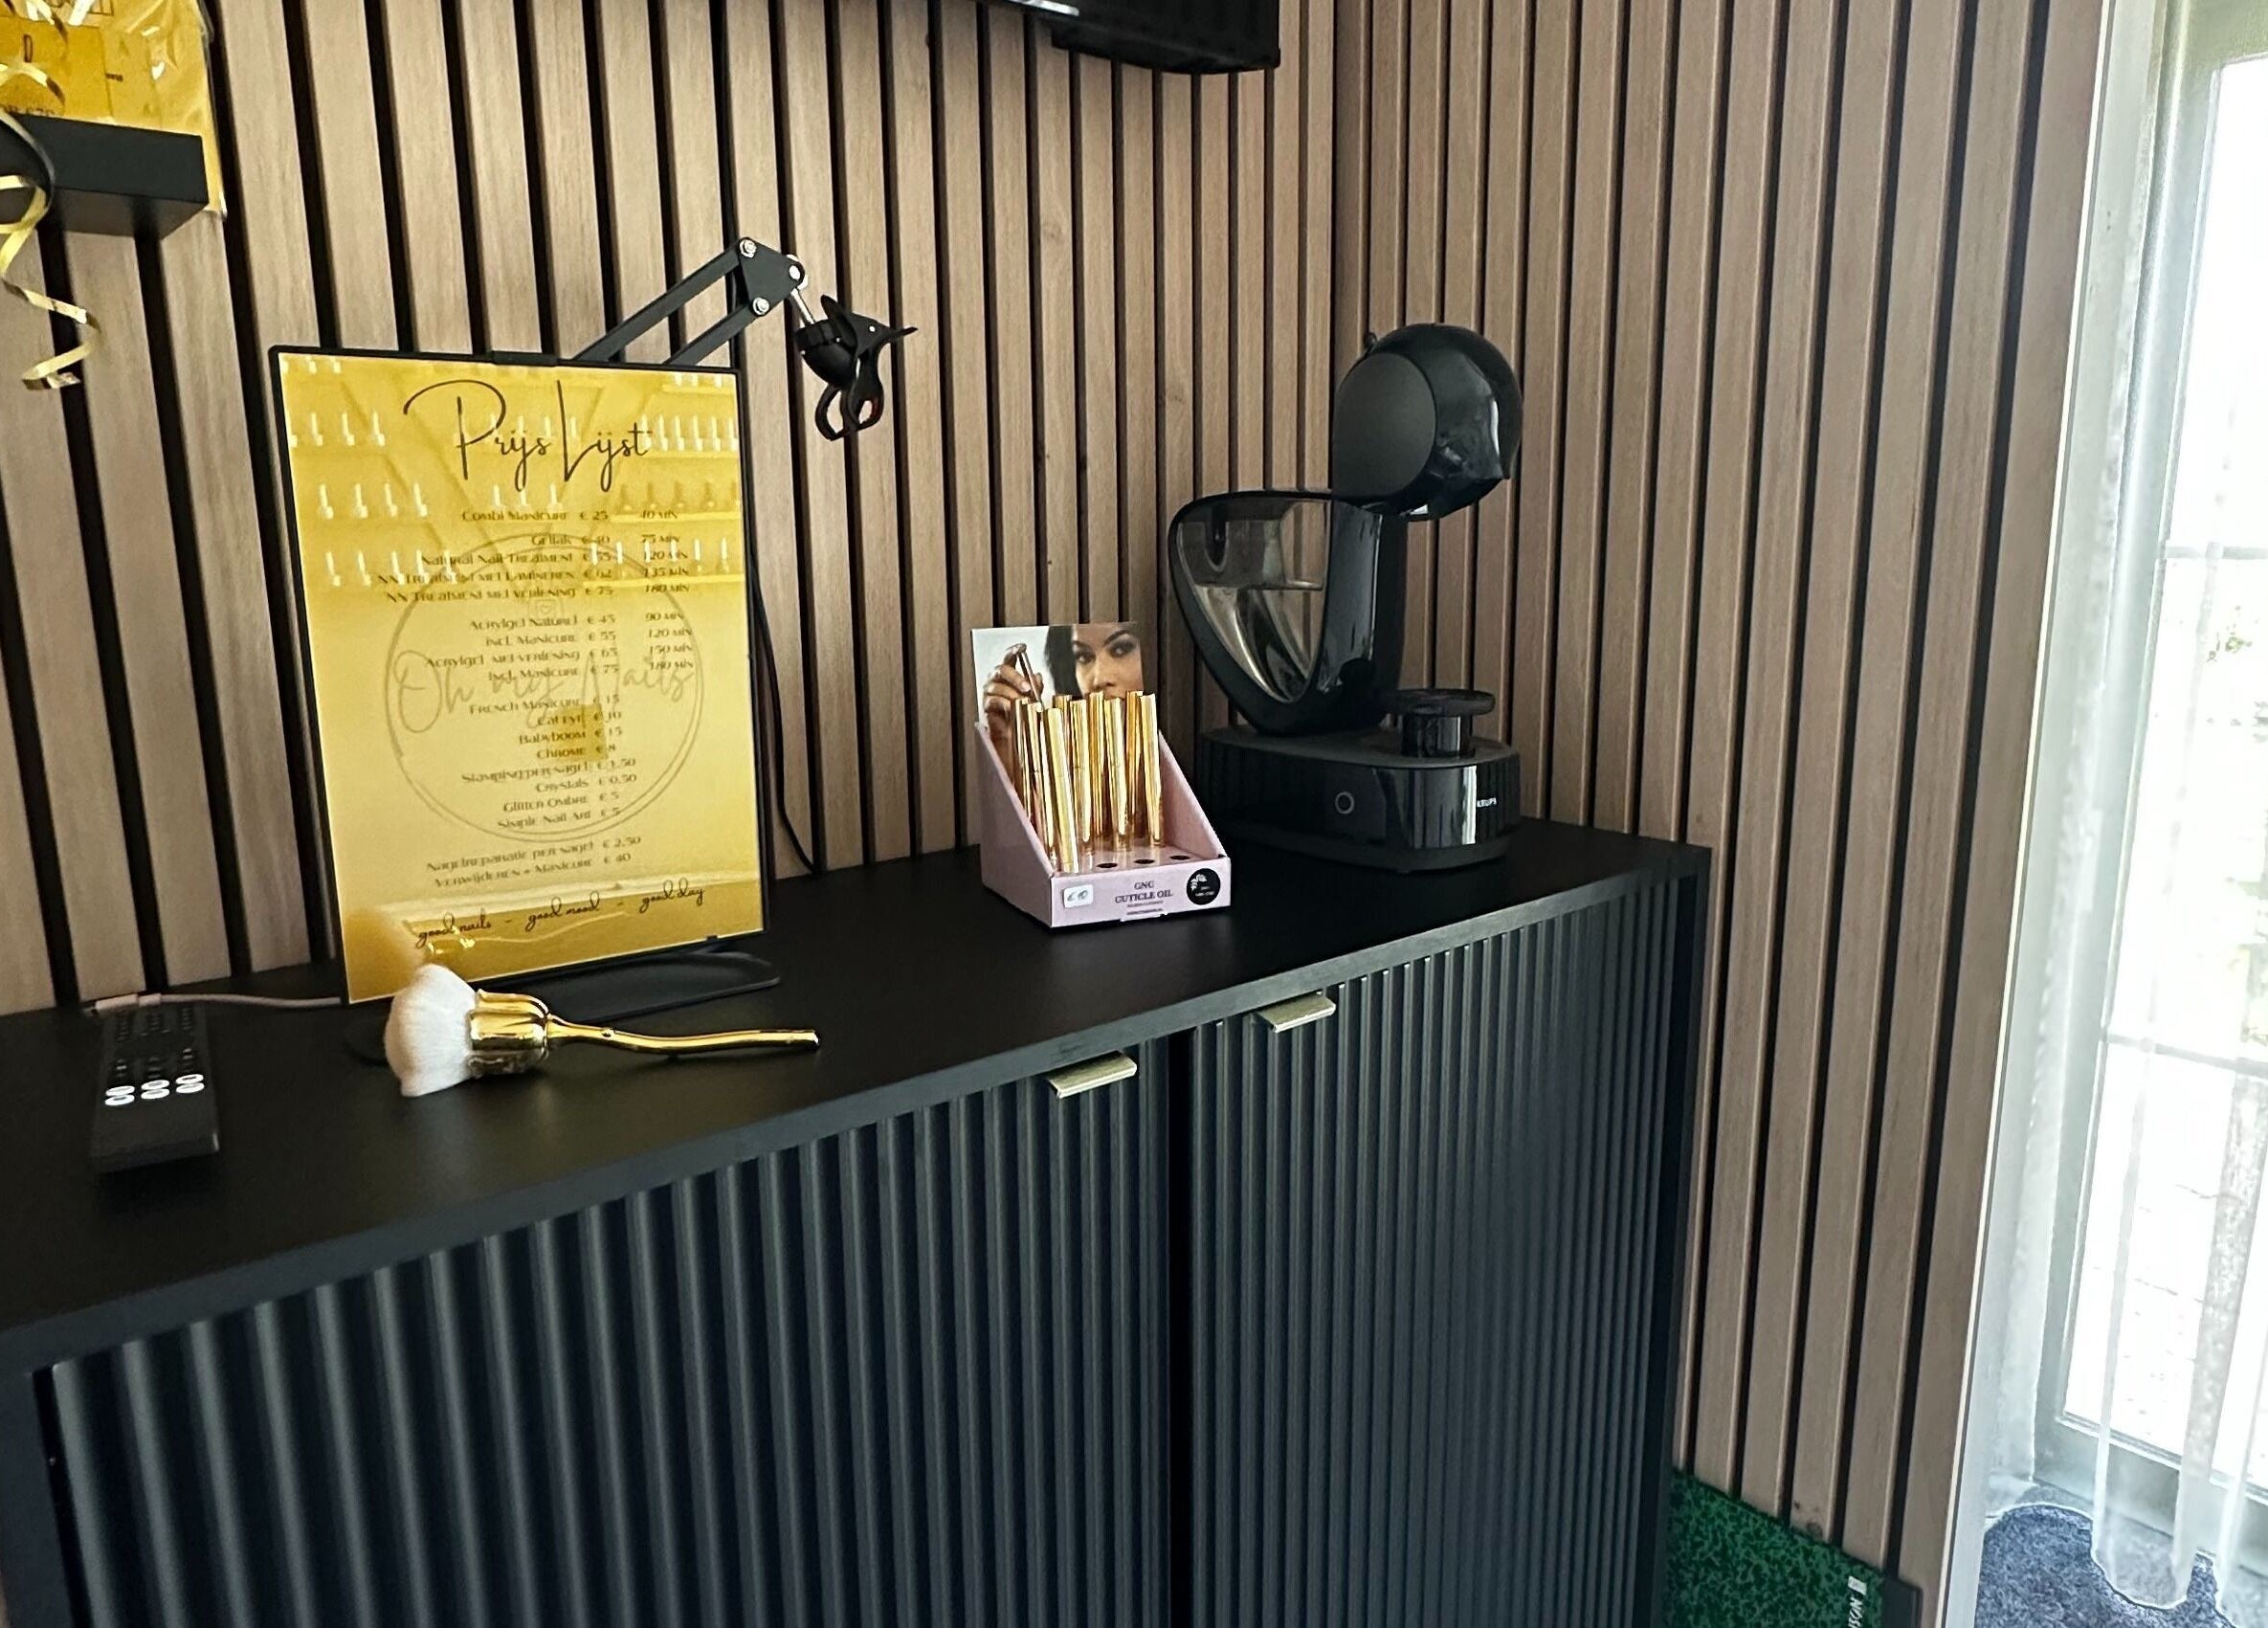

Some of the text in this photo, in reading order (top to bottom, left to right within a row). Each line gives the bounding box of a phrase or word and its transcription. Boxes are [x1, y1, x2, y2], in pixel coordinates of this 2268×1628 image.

[403, 379, 654, 494] Prijs Lijst
[462, 510, 504, 522] Combi
[508, 510, 567, 522] Manicure
[591, 510, 609, 522] 25
[531, 534, 572, 546] Gellak
[597, 585, 613, 596] 75
[598, 613, 615, 624] 45
[600, 630, 616, 641] 55
[393, 649, 475, 734] Oh
[1114, 889, 1174, 903] CUTICLE OIL
[415, 912, 456, 949] good
[525, 896, 563, 933] good
[565, 890, 602, 916] mood
[637, 879, 676, 914] good
[677, 877, 705, 907] day
